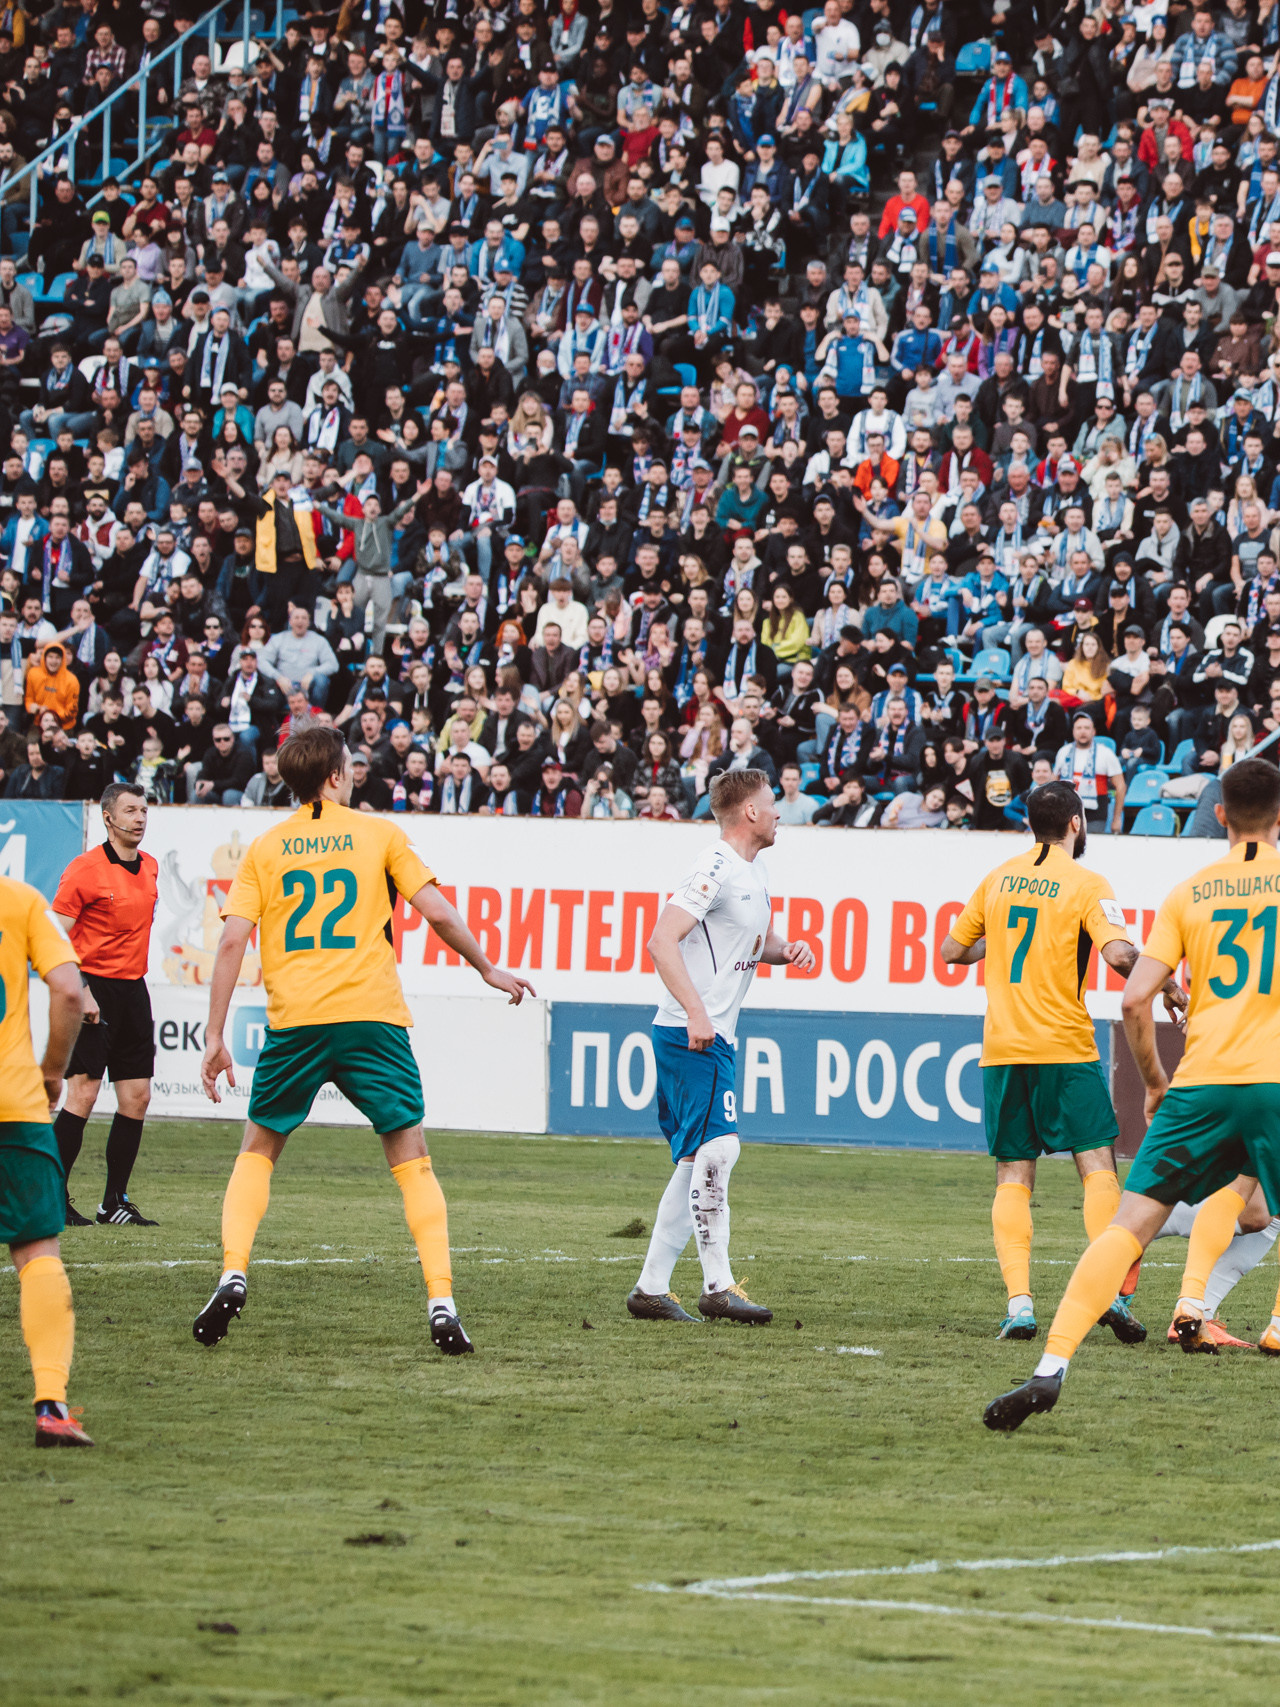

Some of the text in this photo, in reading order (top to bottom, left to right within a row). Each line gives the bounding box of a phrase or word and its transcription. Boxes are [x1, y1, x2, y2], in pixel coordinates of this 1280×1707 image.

[281, 834, 354, 856] ХОМУХА
[281, 868, 358, 953] 22
[1000, 875, 1061, 898] ГУРФОВ
[1007, 905, 1039, 984] 7
[1208, 905, 1279, 1000] 31
[723, 1090, 738, 1124] 9
[815, 1039, 983, 1124] РОСС
